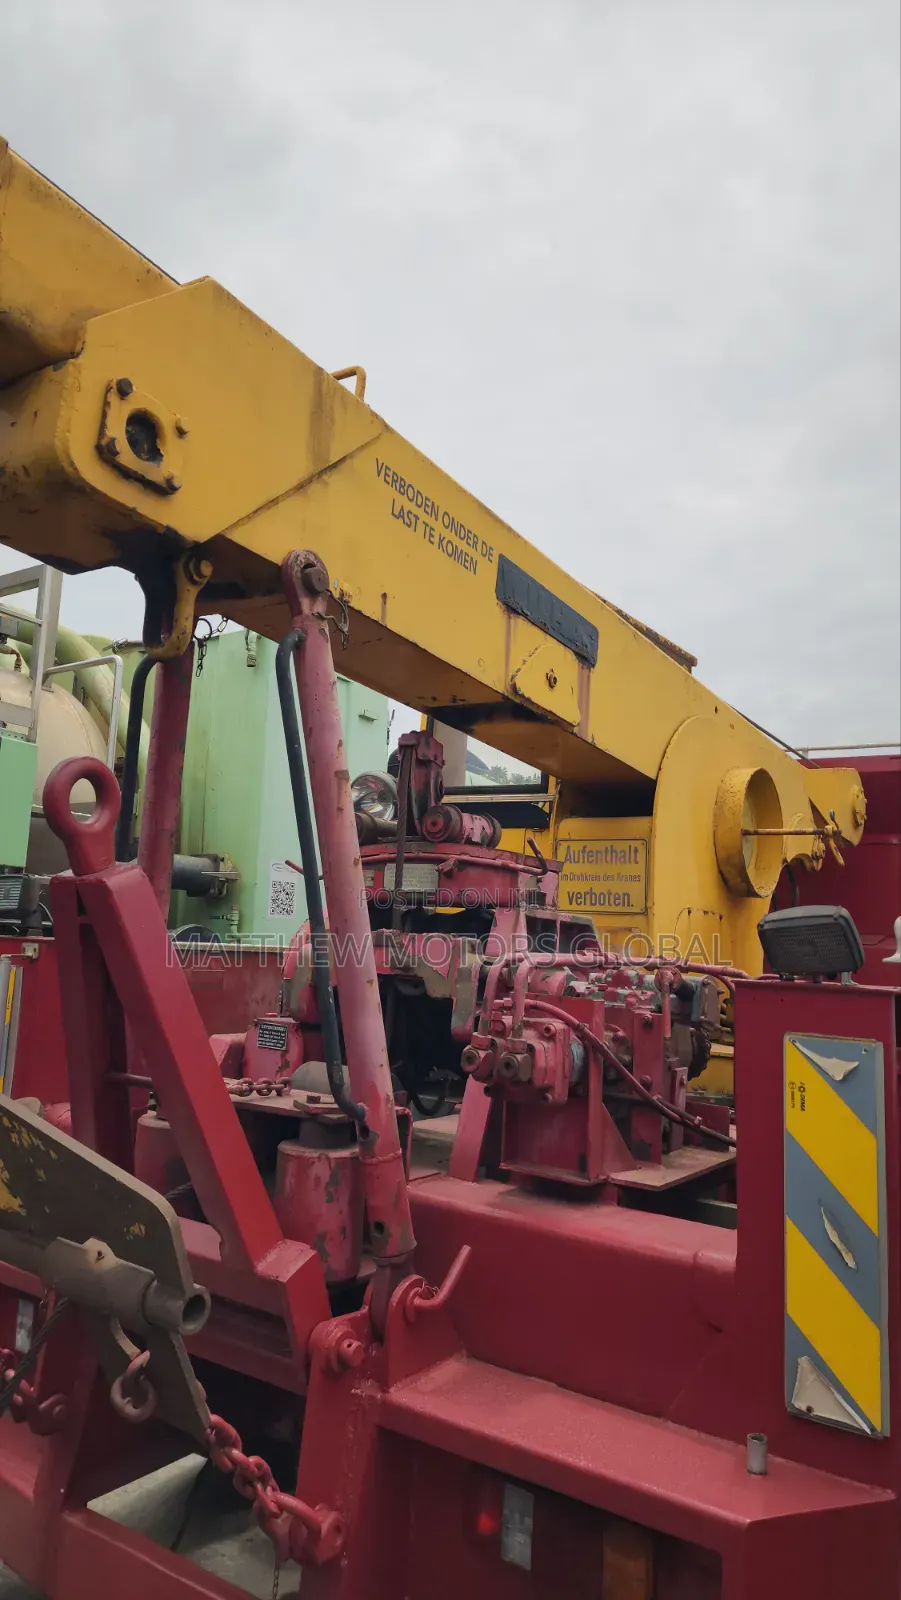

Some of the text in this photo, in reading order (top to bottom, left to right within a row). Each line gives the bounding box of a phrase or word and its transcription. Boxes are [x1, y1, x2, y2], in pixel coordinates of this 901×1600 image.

[375, 457, 494, 564] VERBODEN ONDER DE
[391, 498, 478, 576] LAST TE KOMEN
[565, 845, 639, 865] Aufenthalt
[569, 872, 601, 882] Drehkreis
[602, 872, 615, 882] des
[616, 873, 641, 882] Kranes
[567, 887, 634, 907] verboten.
